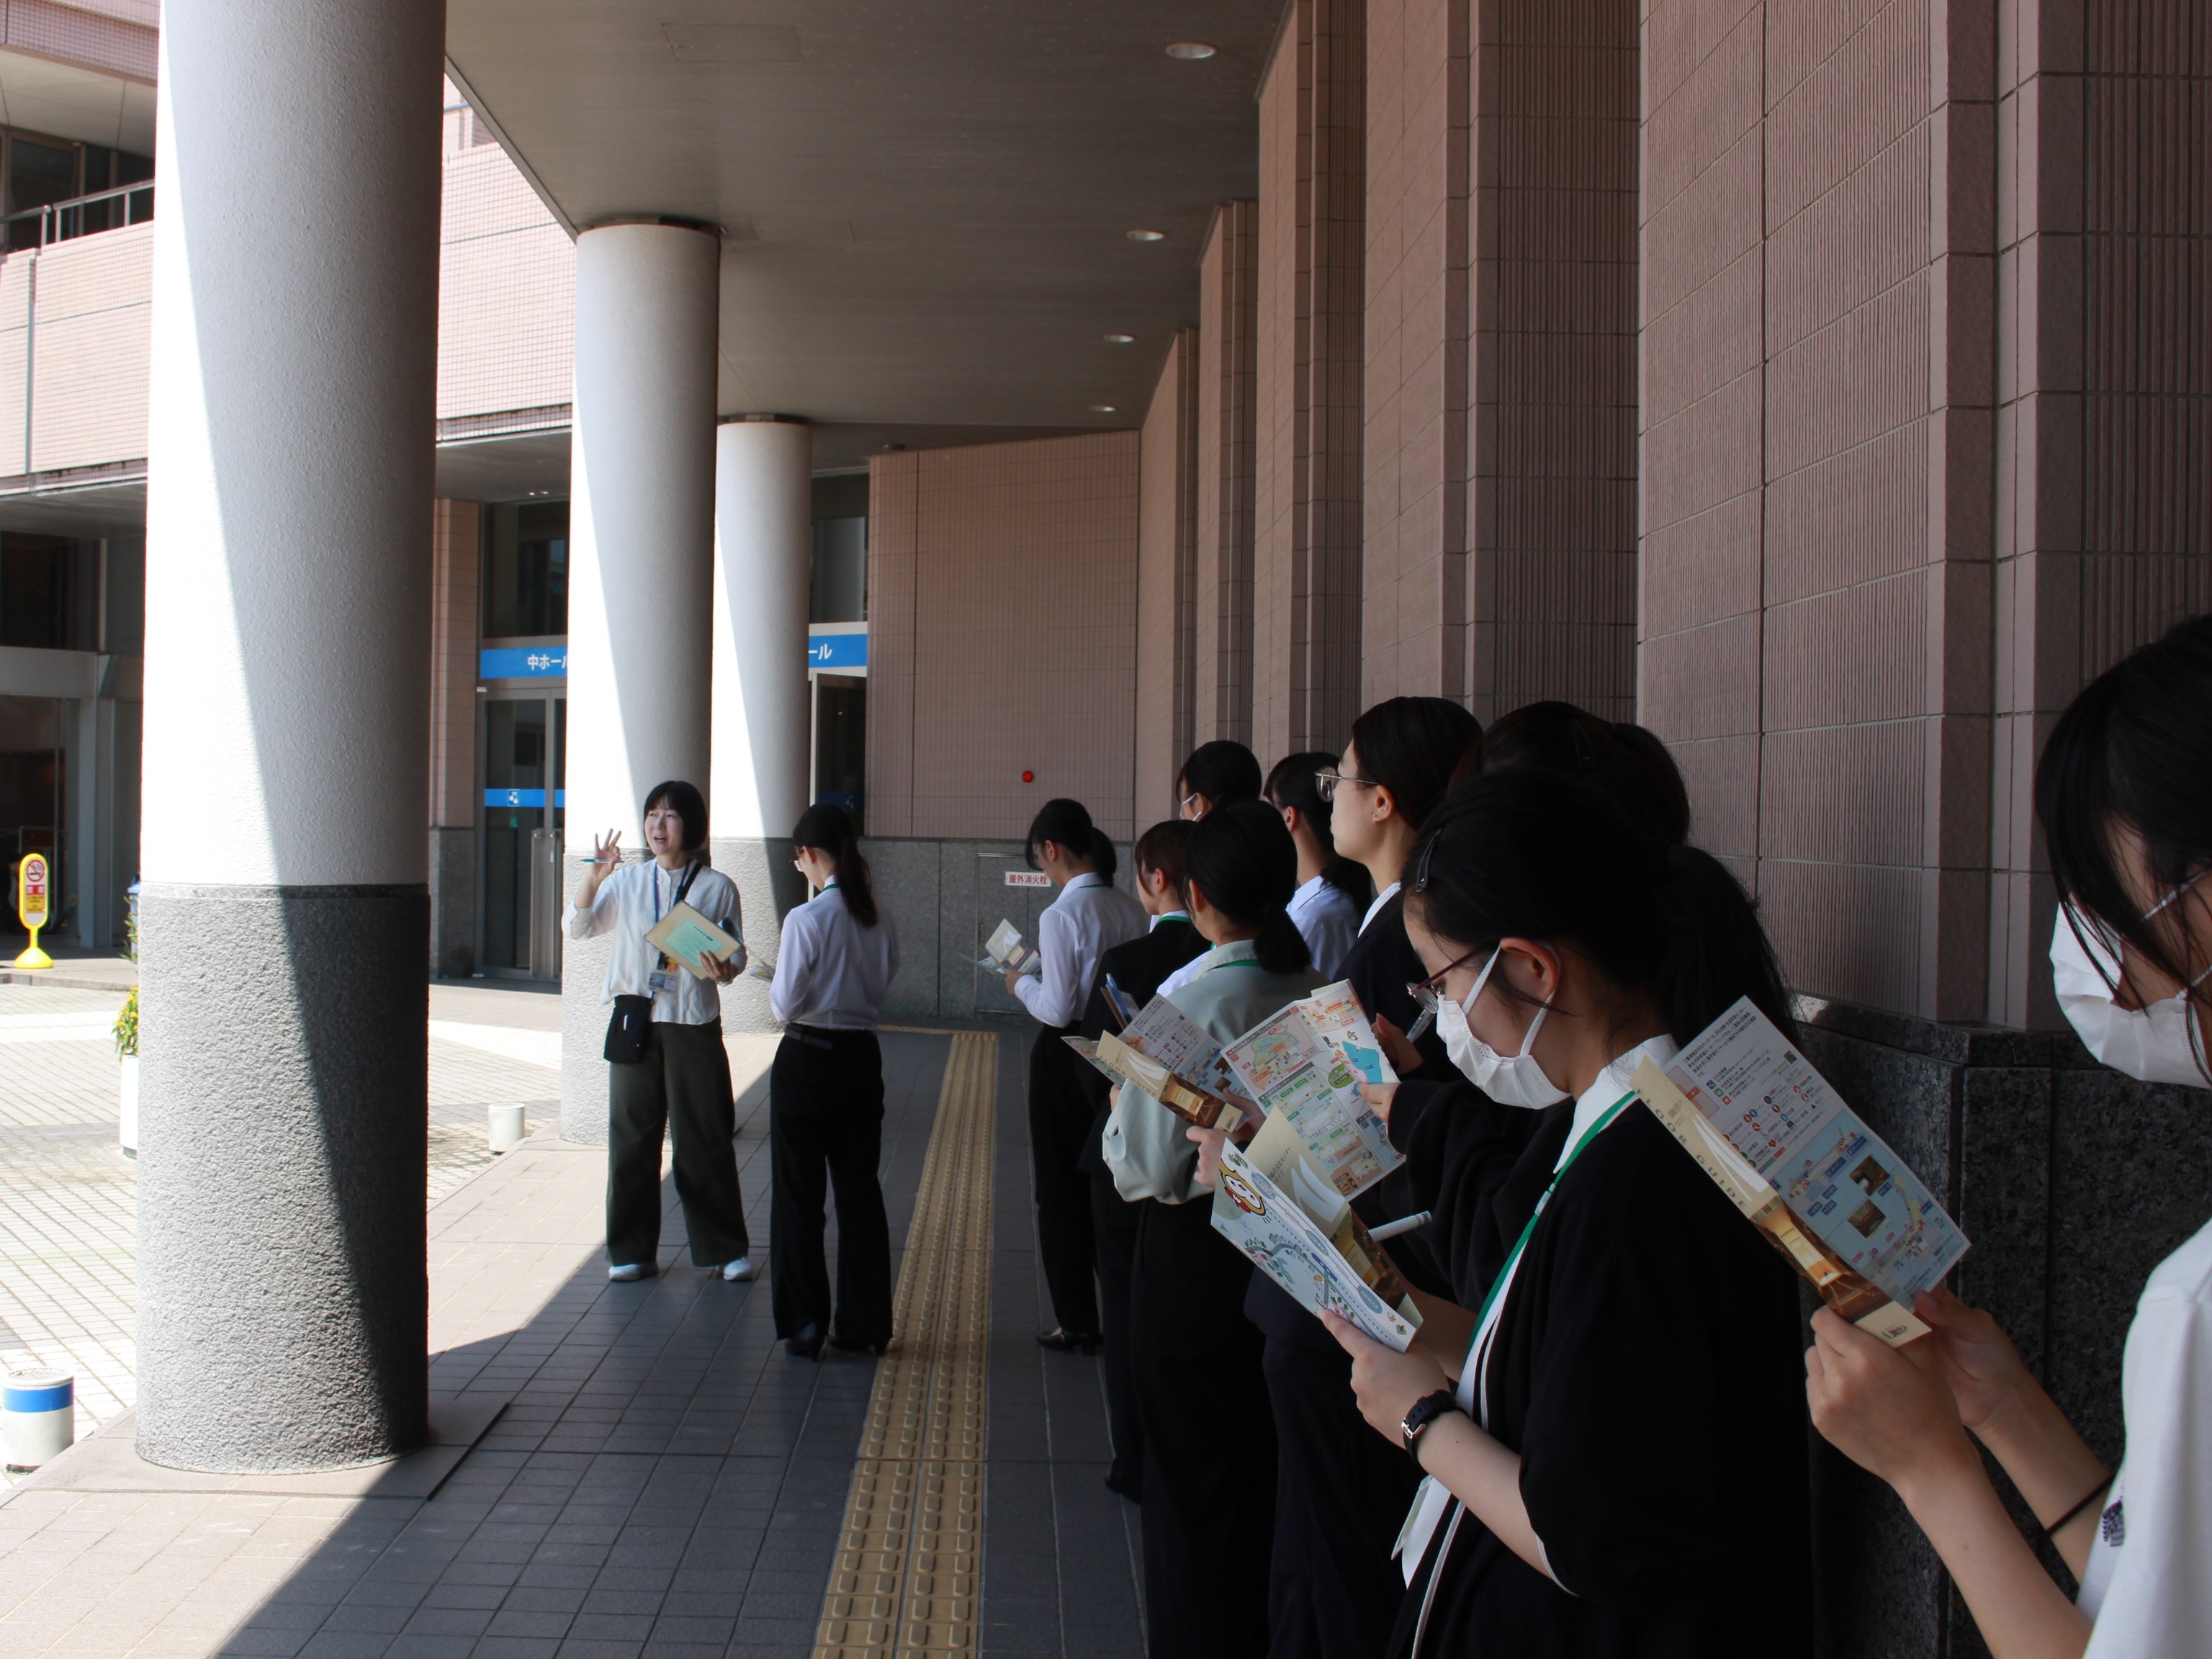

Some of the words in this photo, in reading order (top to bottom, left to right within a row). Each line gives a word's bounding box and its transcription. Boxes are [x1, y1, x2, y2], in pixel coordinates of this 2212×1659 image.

[1010, 874, 1048, 884] 屋外消火栓
[1635, 1087, 1688, 1144] FLOOR
[1694, 1153, 1747, 1210] GUIDE
